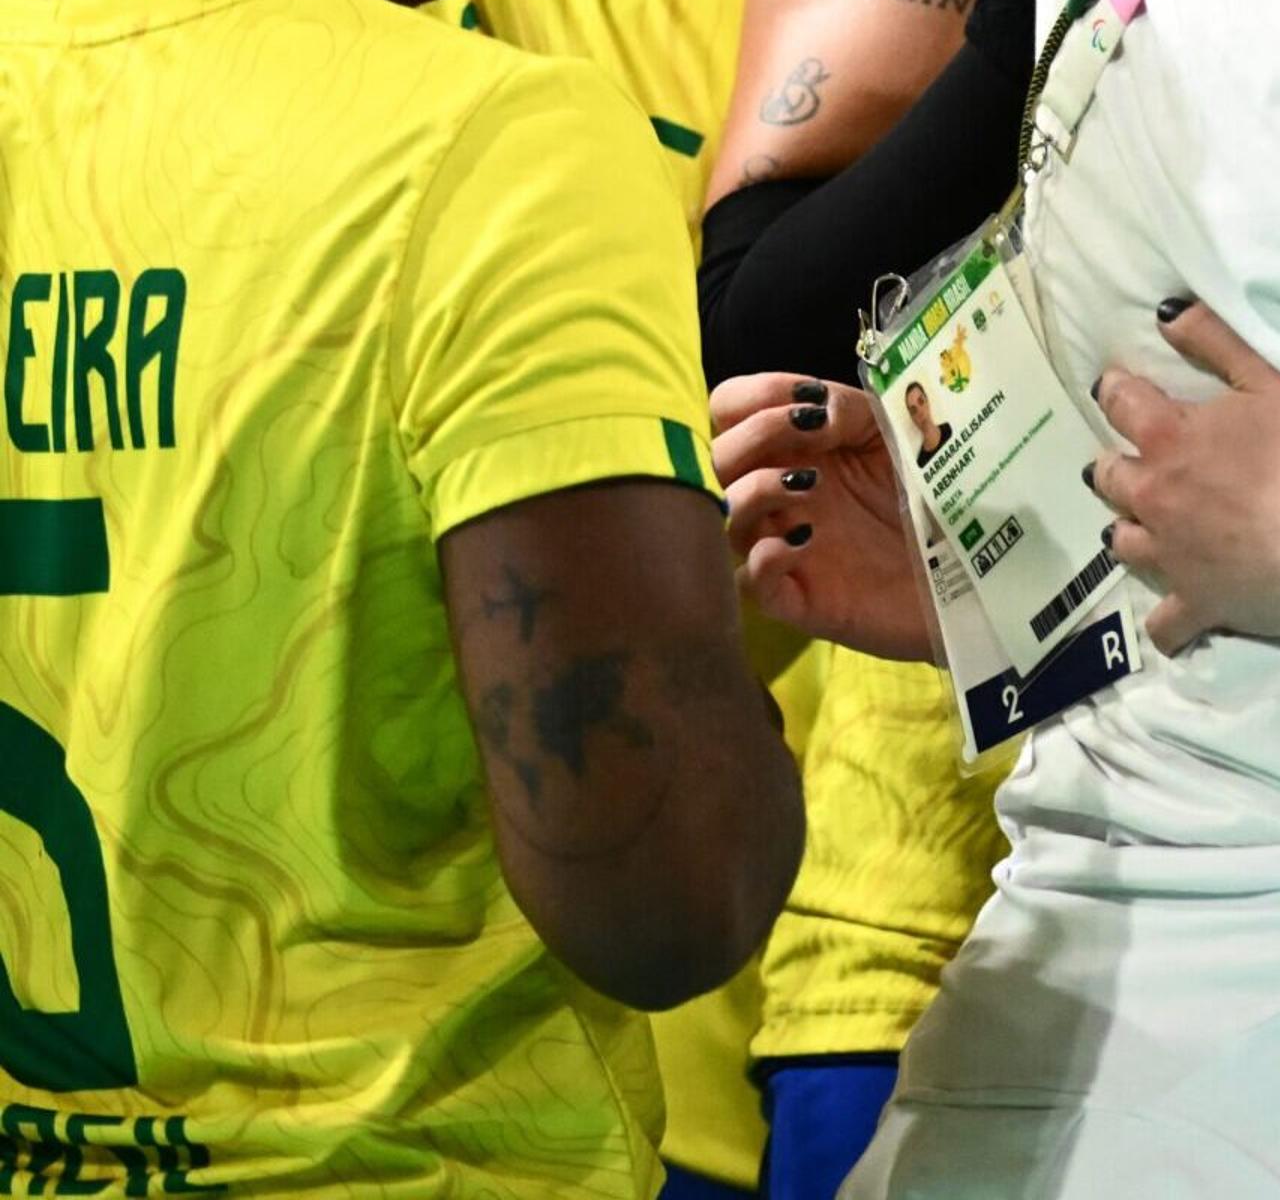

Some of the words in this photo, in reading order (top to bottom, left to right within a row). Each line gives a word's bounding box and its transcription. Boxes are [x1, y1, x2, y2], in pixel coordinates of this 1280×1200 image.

[5, 268, 187, 453] EIRA
[922, 438, 962, 484] BARBARA
[960, 389, 1006, 444] ELISABETH
[932, 446, 976, 500] ARENHART
[1002, 684, 1024, 725] 2
[1101, 630, 1125, 671] R
